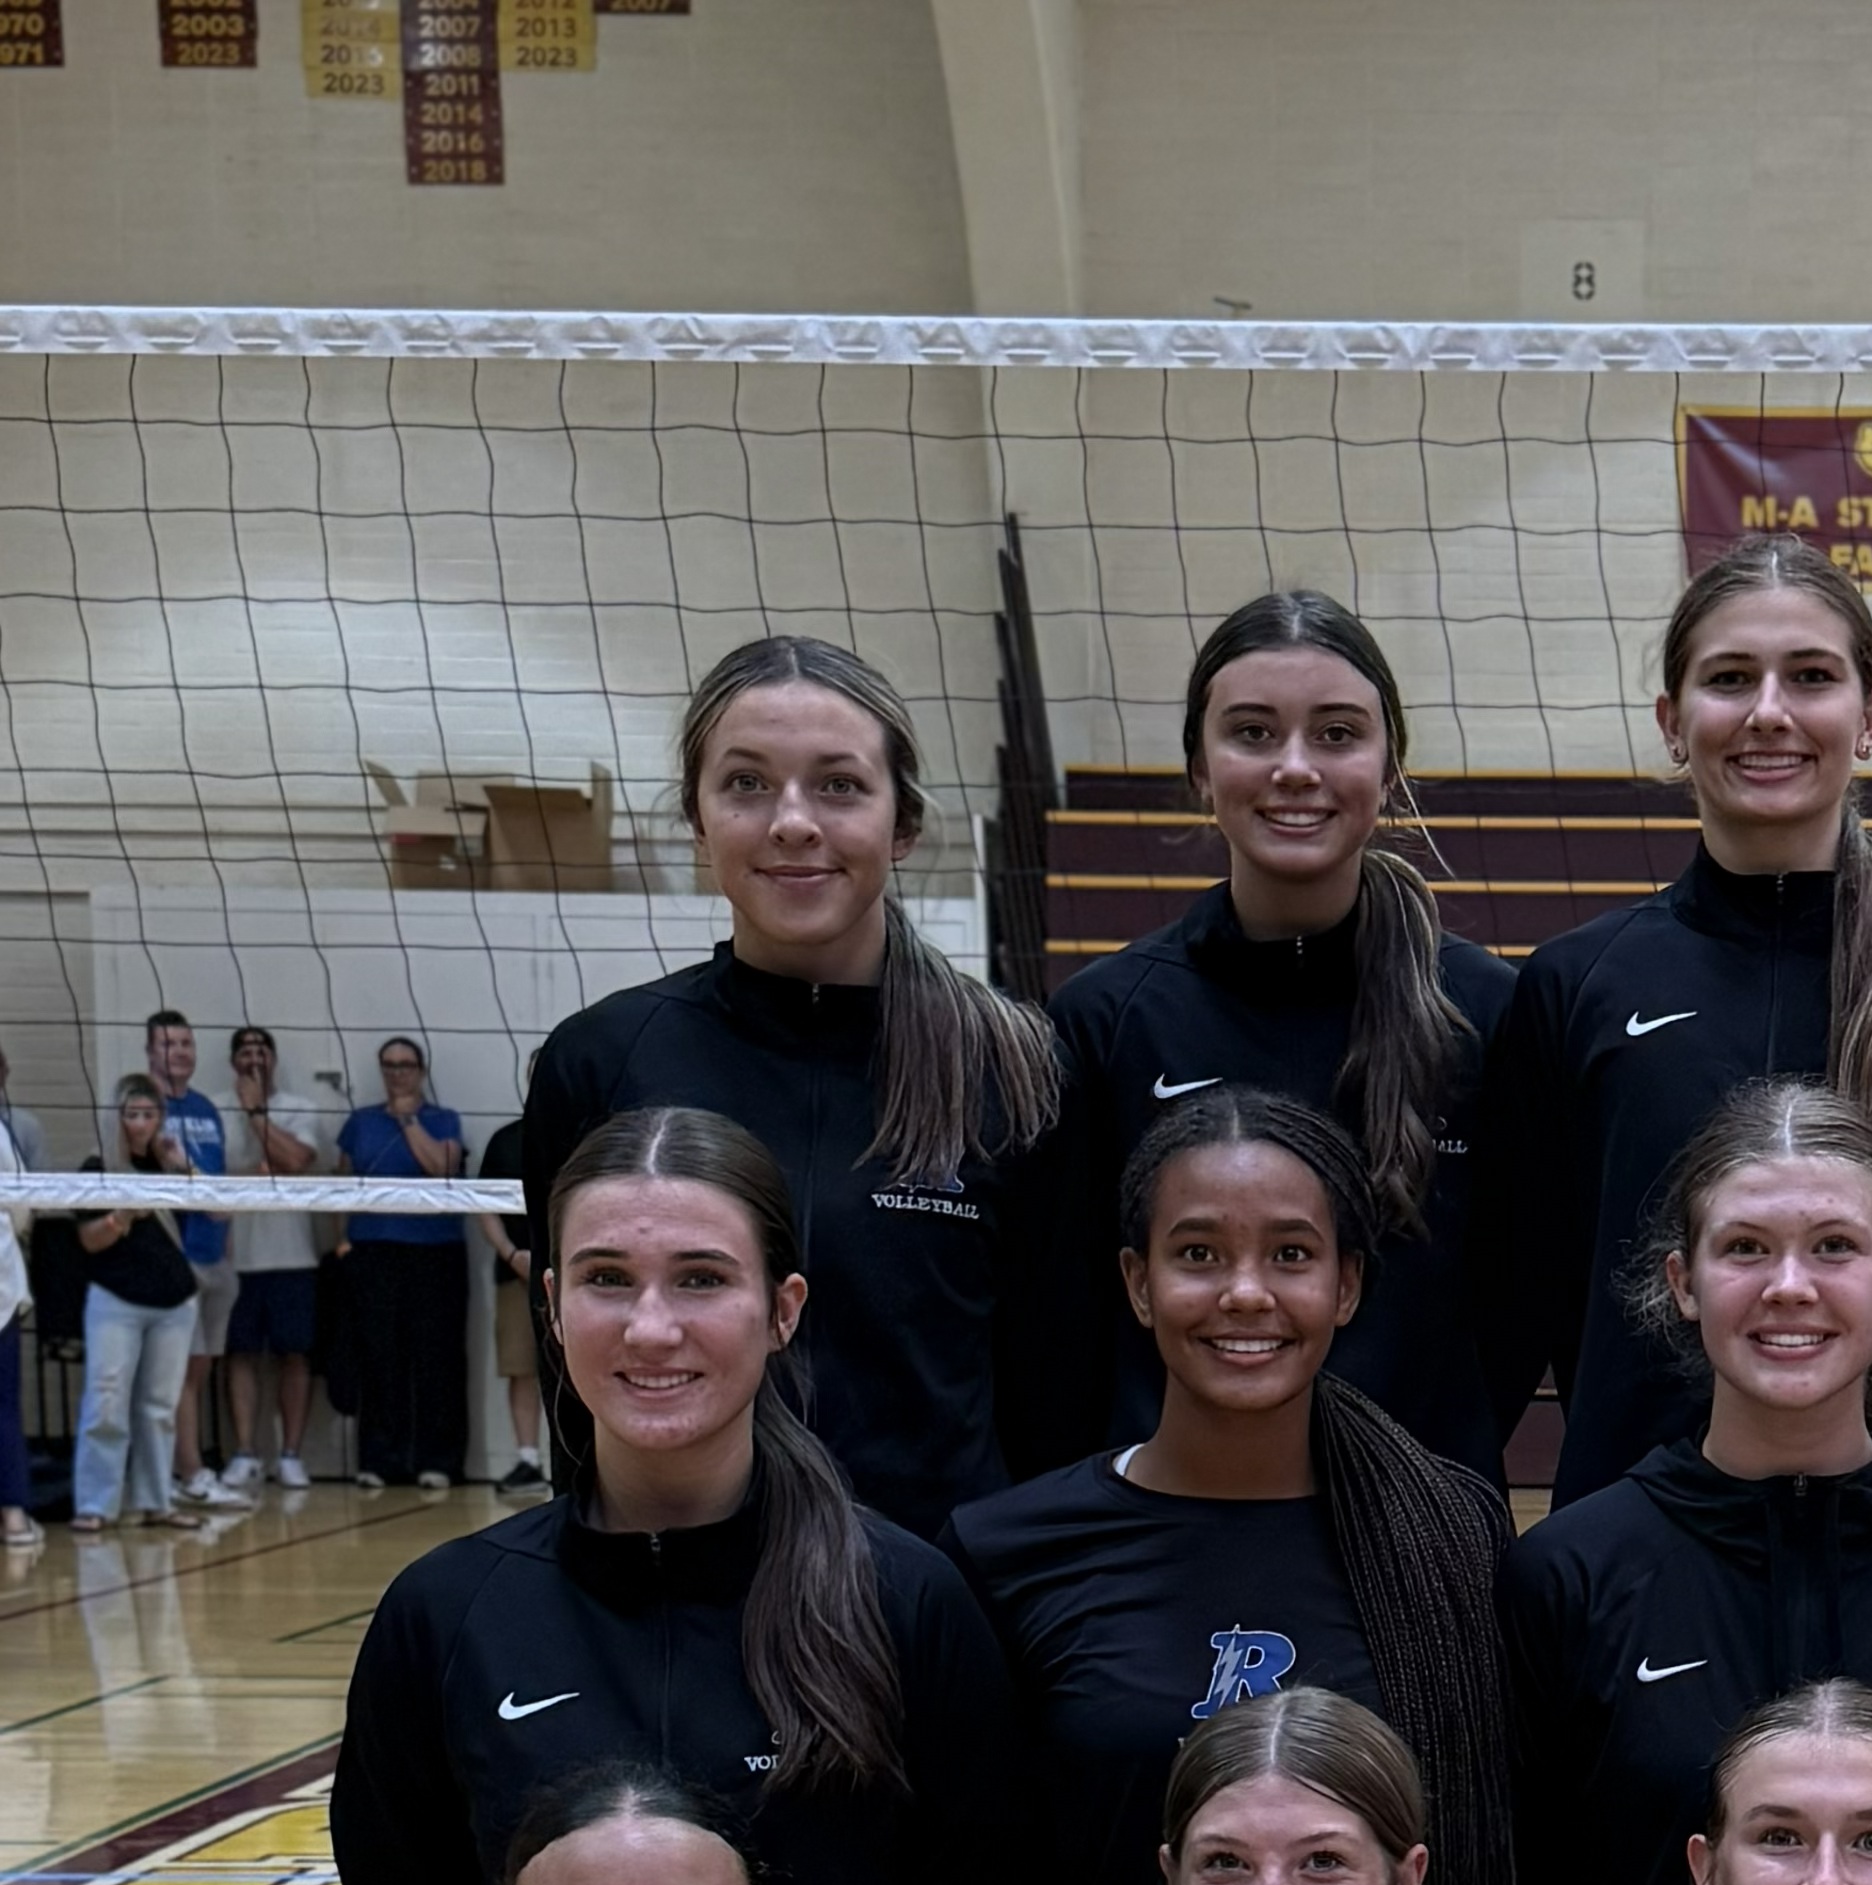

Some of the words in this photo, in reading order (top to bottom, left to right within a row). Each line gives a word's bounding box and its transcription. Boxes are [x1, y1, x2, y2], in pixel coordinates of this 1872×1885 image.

[171, 14, 245, 36] 2003
[418, 15, 481, 38] 2007
[516, 17, 577, 38] 2013
[177, 43, 241, 65] 2023
[419, 44, 482, 67] 2008
[516, 46, 578, 67] 2023
[323, 73, 385, 95] 2023
[424, 74, 480, 96] 2011
[421, 103, 484, 125] 2014
[421, 131, 485, 154] 2016
[423, 160, 487, 182] 2018
[1573, 261, 1595, 301] 8
[1741, 495, 1819, 528] M-A
[871, 1193, 980, 1219] VOLLEYBALL
[1191, 1623, 1297, 1719] R
